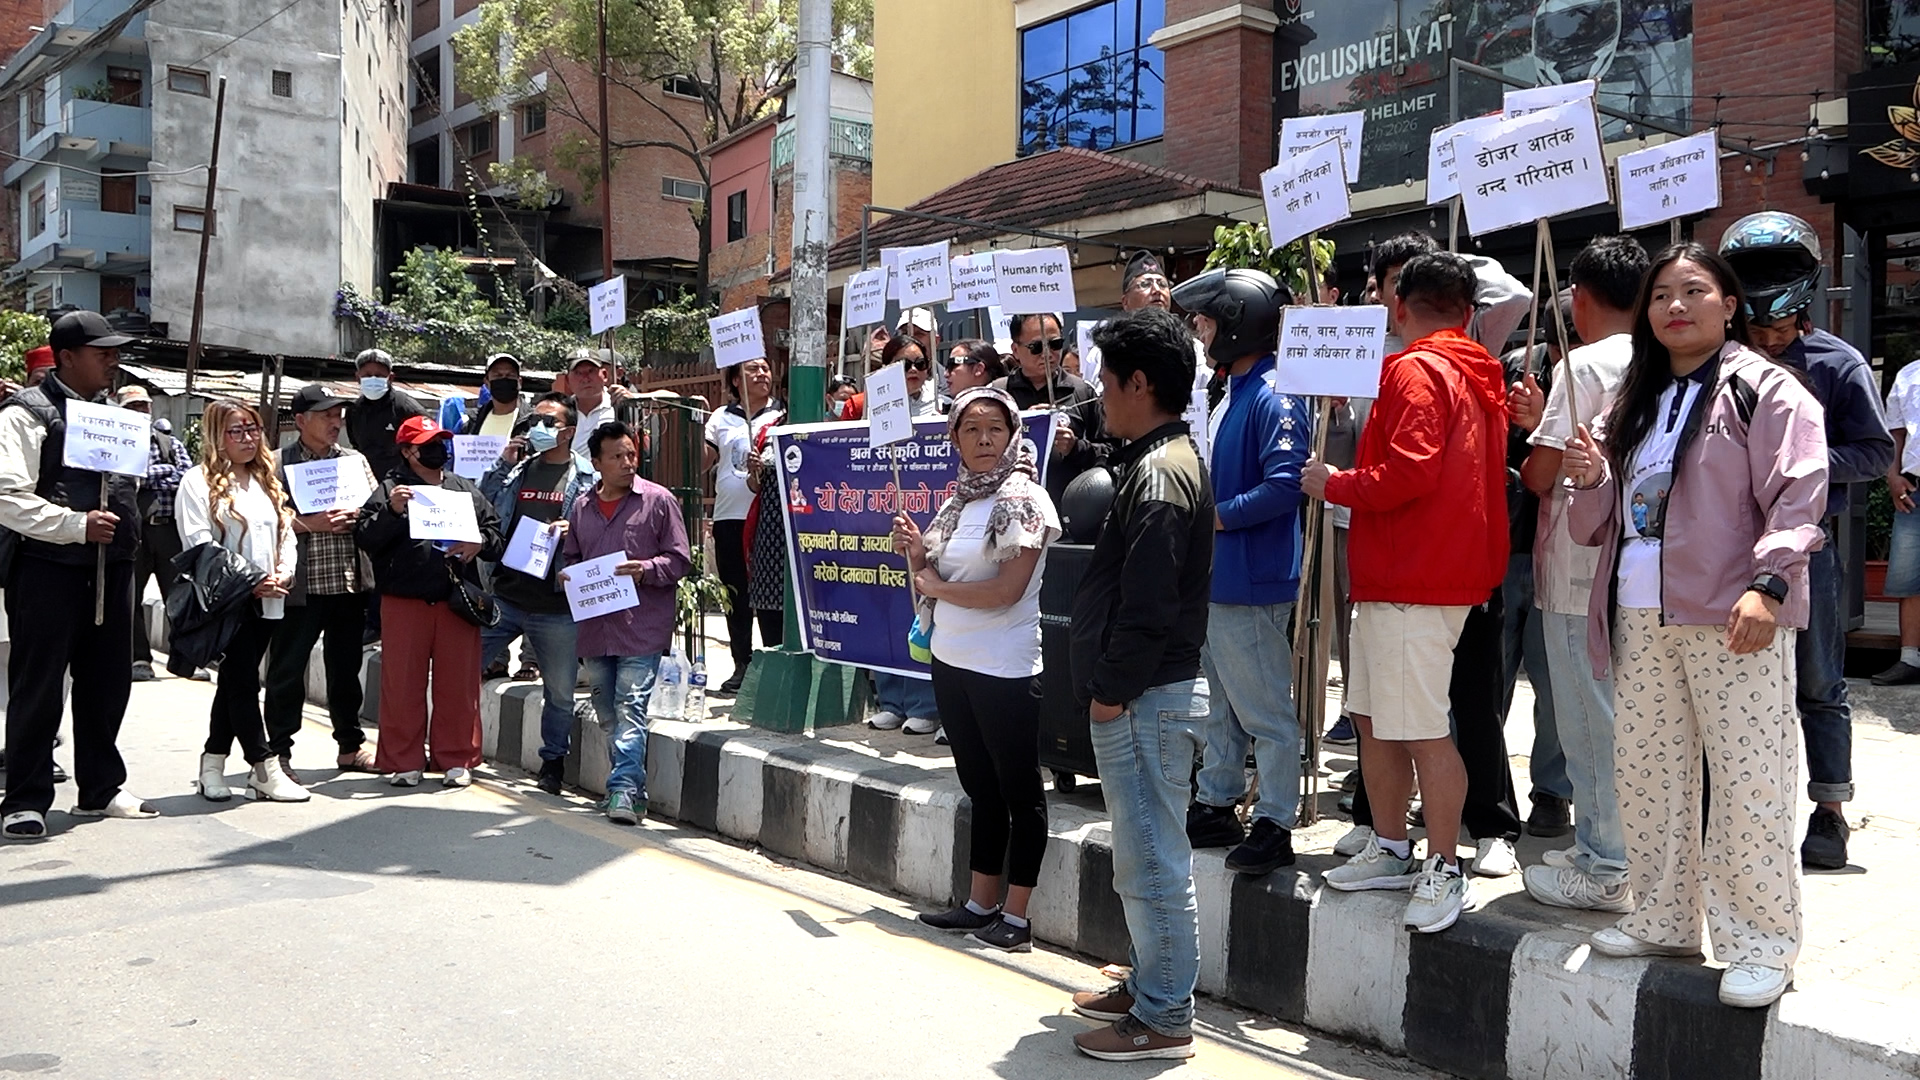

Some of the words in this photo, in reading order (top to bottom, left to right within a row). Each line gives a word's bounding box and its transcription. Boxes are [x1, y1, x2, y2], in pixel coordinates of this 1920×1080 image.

[1281, 24, 1421, 91] EXCLUSIVELY
[1427, 13, 1457, 54] AT
[1371, 93, 1437, 121] HELMET
[1384, 118, 1418, 137] 2026
[1474, 143, 1519, 168] डोजर
[1527, 127, 1575, 152] आतंक
[1660, 148, 1705, 170] अधिकारको
[1514, 159, 1574, 187] गरियोस
[1649, 177, 1669, 192] लागि
[1672, 173, 1687, 187] एक
[1271, 185, 1280, 198] यो
[1286, 198, 1300, 213] पनि
[1303, 192, 1313, 206] हो
[959, 265, 979, 276] Stand
[1002, 265, 1037, 276] Human
[1040, 263, 1063, 276] right
[952, 279, 976, 290] Defend
[977, 277, 997, 286] Hum
[1011, 284, 1037, 293] come
[1039, 282, 1060, 293] first
[967, 291, 990, 301] Rights
[1345, 326, 1375, 337] कपास
[1286, 344, 1308, 359] हाम्रो
[1313, 343, 1351, 359] अधिकार
[1355, 345, 1367, 360] हो
[850, 446, 871, 461] श्रम
[924, 441, 952, 457] पार्टी
[838, 482, 864, 514] देश
[839, 534, 859, 551] तथा
[813, 560, 838, 582] गरेको
[840, 567, 877, 584] दमनका
[578, 576, 618, 594] सरकारको,
[577, 596, 597, 608] जनता
[597, 588, 622, 605] कस्को
